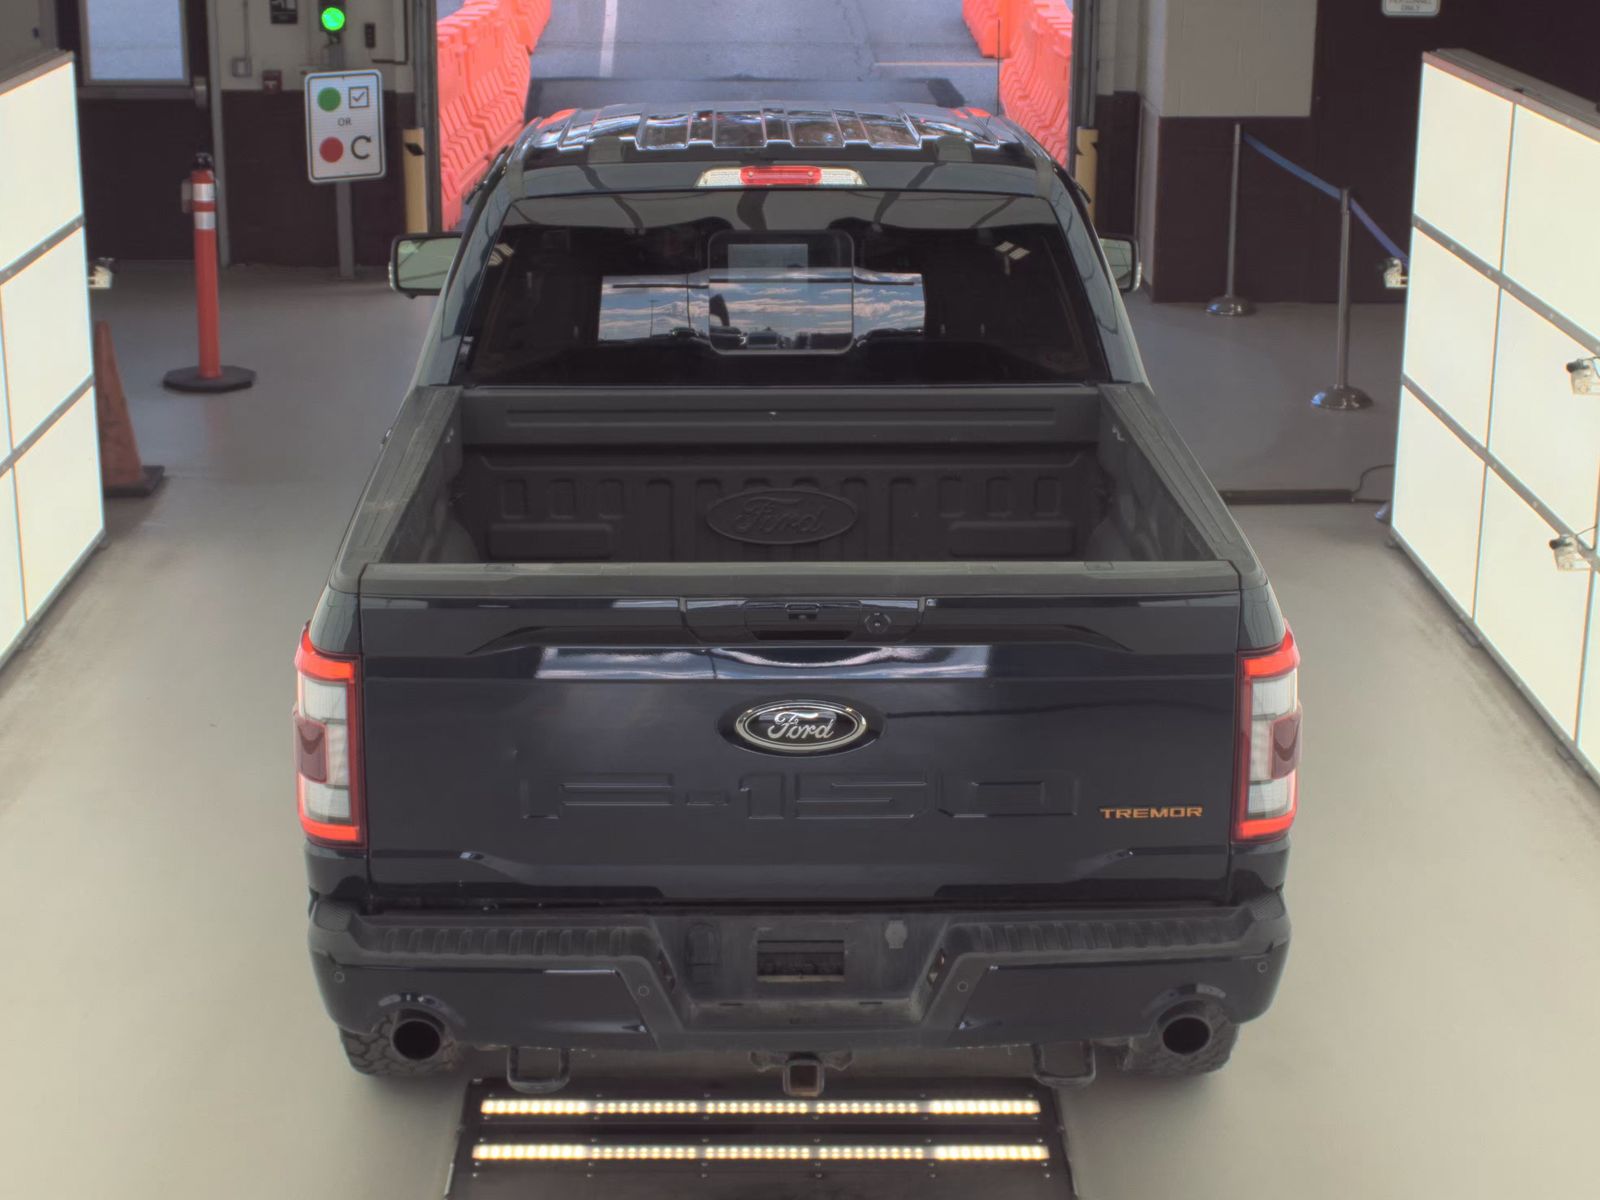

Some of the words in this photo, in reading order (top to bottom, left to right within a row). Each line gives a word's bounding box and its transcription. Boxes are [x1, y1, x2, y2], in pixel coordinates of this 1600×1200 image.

[337, 117, 352, 126] OR
[735, 496, 826, 533] Ford
[767, 711, 834, 739] Ford
[520, 770, 1078, 819] F-150
[1100, 807, 1203, 819] TREMOR
